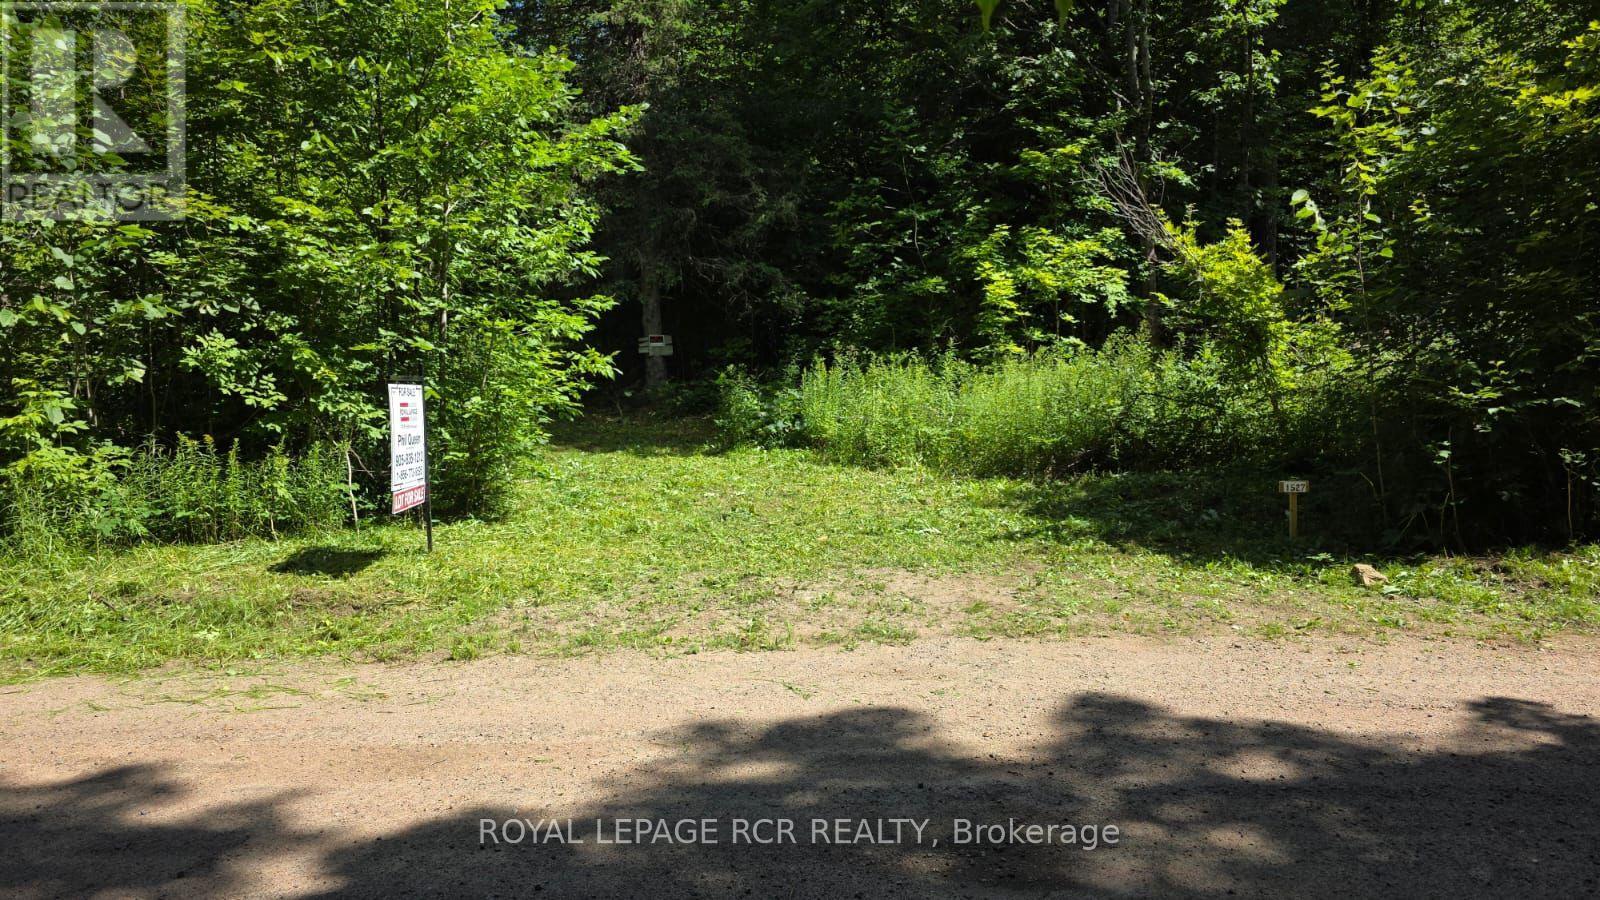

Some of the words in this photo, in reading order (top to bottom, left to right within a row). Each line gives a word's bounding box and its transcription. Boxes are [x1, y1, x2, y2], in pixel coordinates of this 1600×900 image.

[397, 434, 407, 446] Phil
[1286, 483, 1306, 492] 1527
[395, 494, 405, 509] LOT
[404, 490, 413, 505] FOR
[413, 487, 424, 502] SALE
